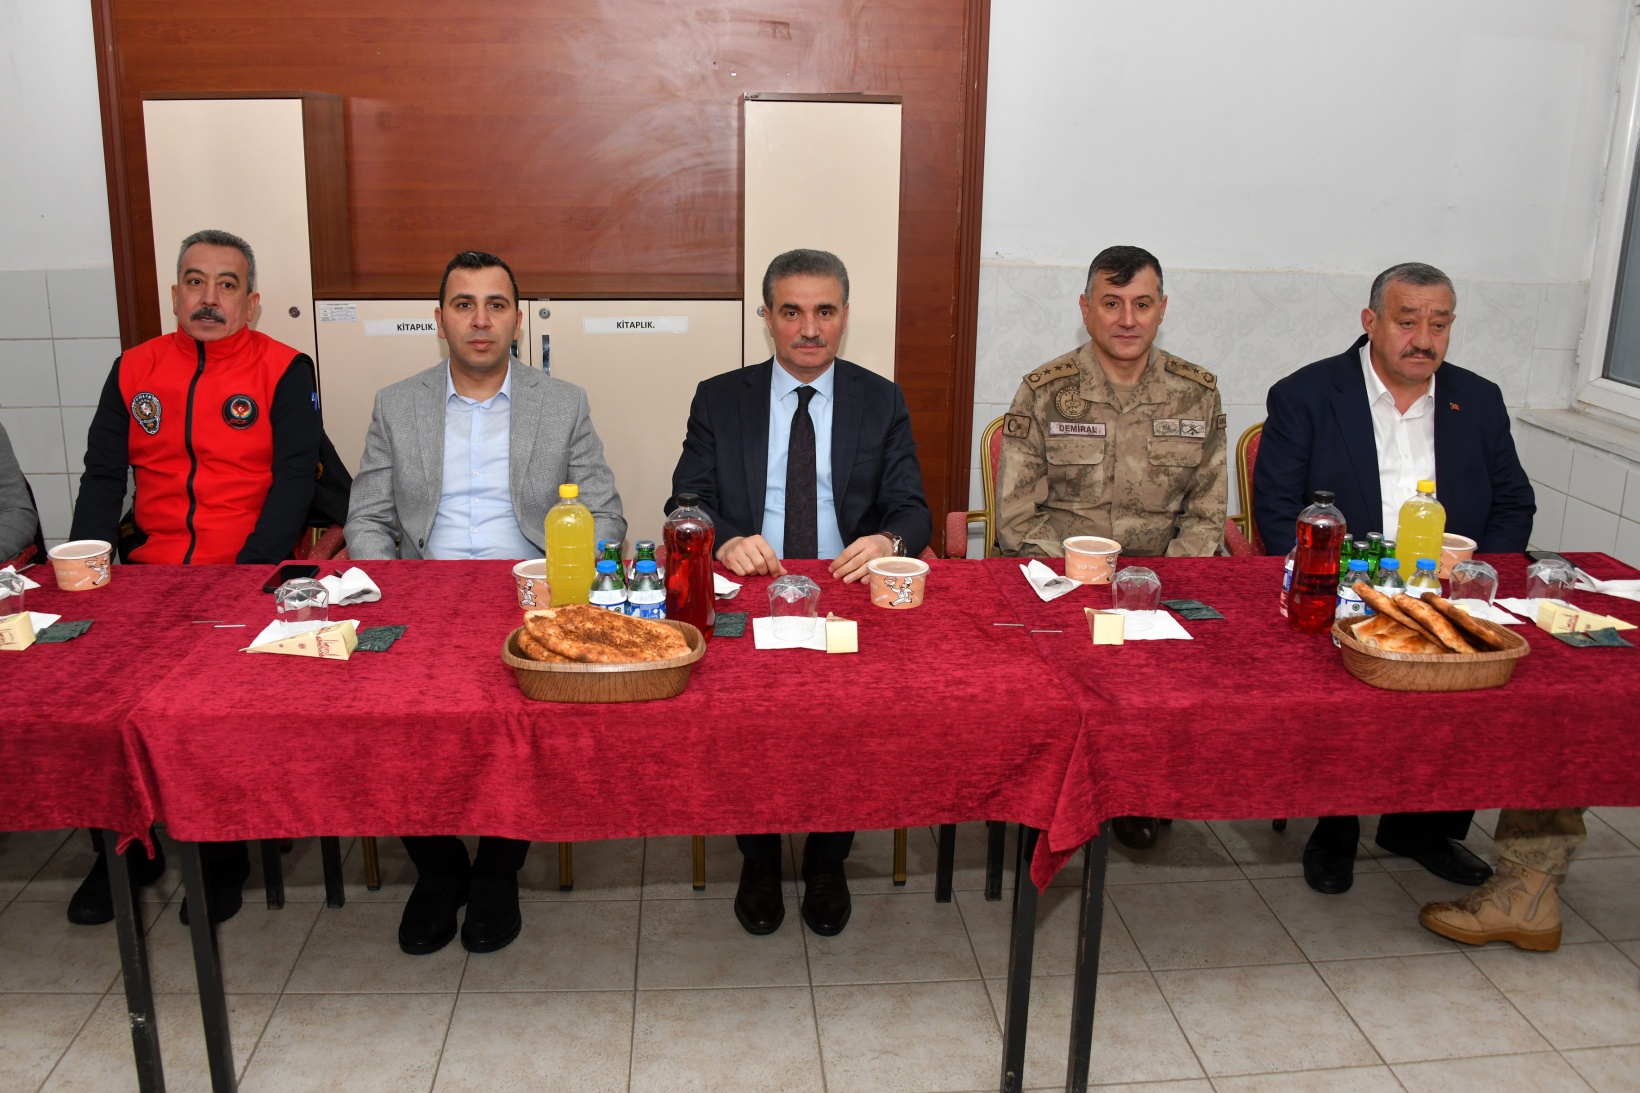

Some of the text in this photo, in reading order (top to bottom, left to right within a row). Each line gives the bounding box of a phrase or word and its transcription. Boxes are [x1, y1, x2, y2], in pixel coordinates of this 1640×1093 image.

[397, 323, 436, 332] KİTAPLIK.
[616, 320, 655, 329] KİTAPLIK.
[1059, 424, 1097, 433] DEMİRAL
